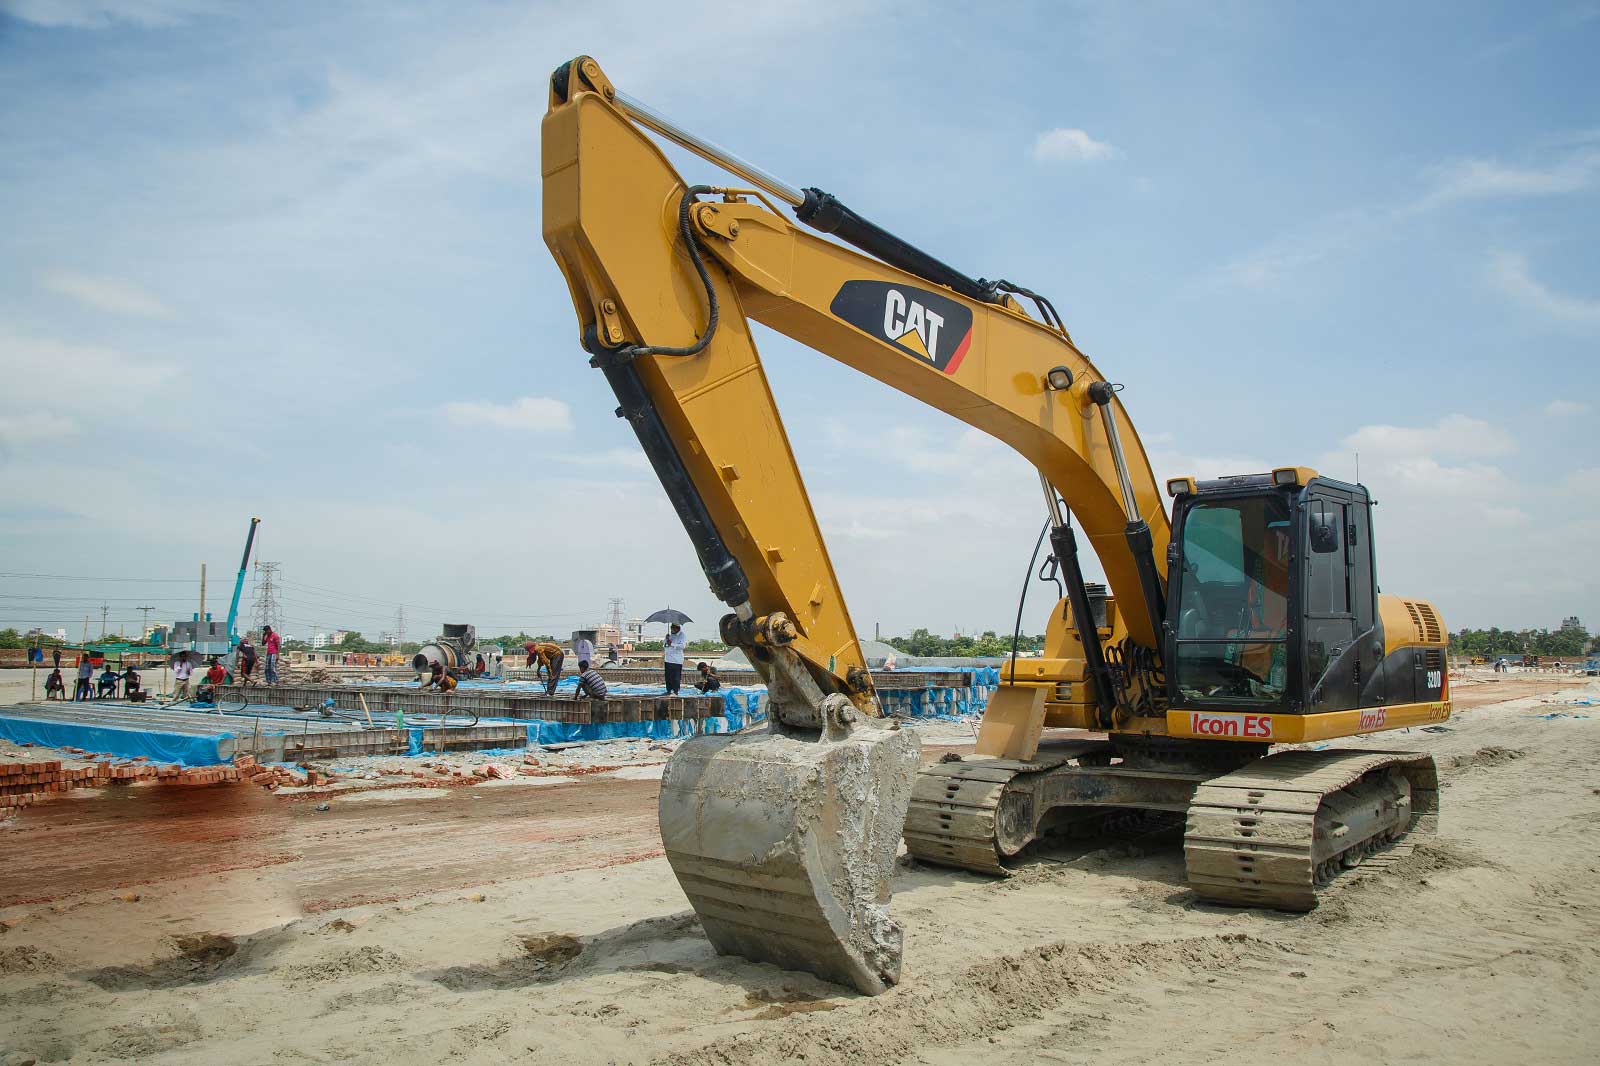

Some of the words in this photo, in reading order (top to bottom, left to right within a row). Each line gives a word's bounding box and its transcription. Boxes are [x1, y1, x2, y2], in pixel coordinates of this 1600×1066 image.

[884, 289, 944, 362] CAT
[1427, 670, 1442, 689] 320D
[1358, 710, 1376, 730] Icon
[1375, 708, 1386, 728] ES
[1428, 704, 1442, 721] Icon
[1192, 713, 1238, 736] Icon
[1243, 715, 1272, 738] ES
